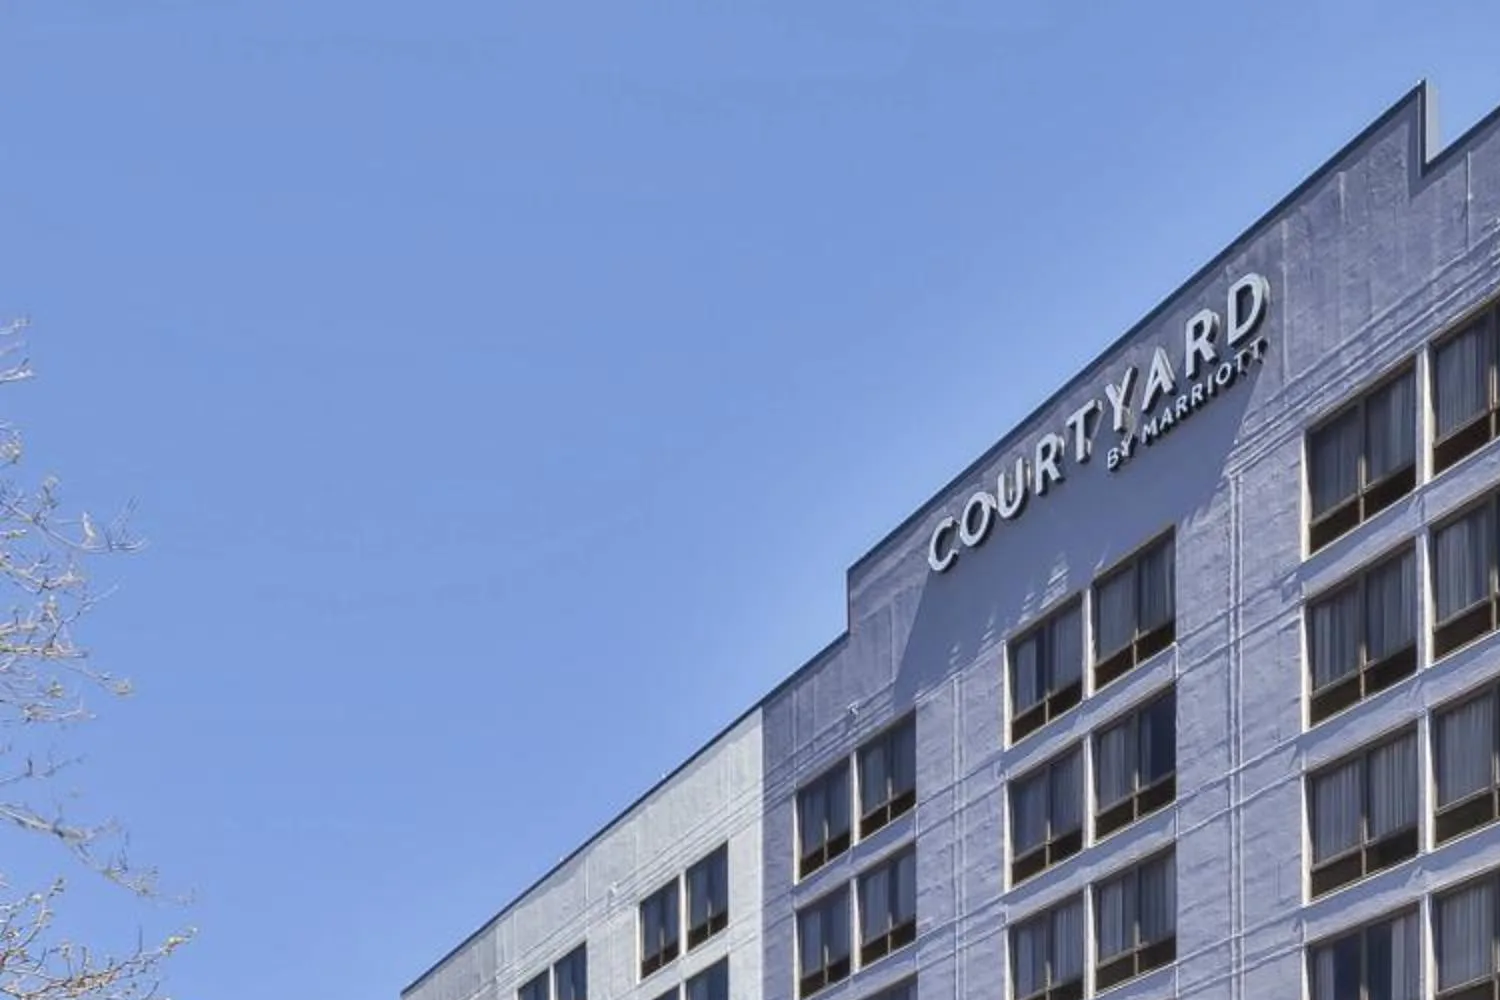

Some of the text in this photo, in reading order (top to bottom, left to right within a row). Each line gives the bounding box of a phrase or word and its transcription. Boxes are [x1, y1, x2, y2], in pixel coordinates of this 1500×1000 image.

[928, 272, 1269, 571] COURTYARD
[1107, 335, 1266, 470] BY MARRIOTT
